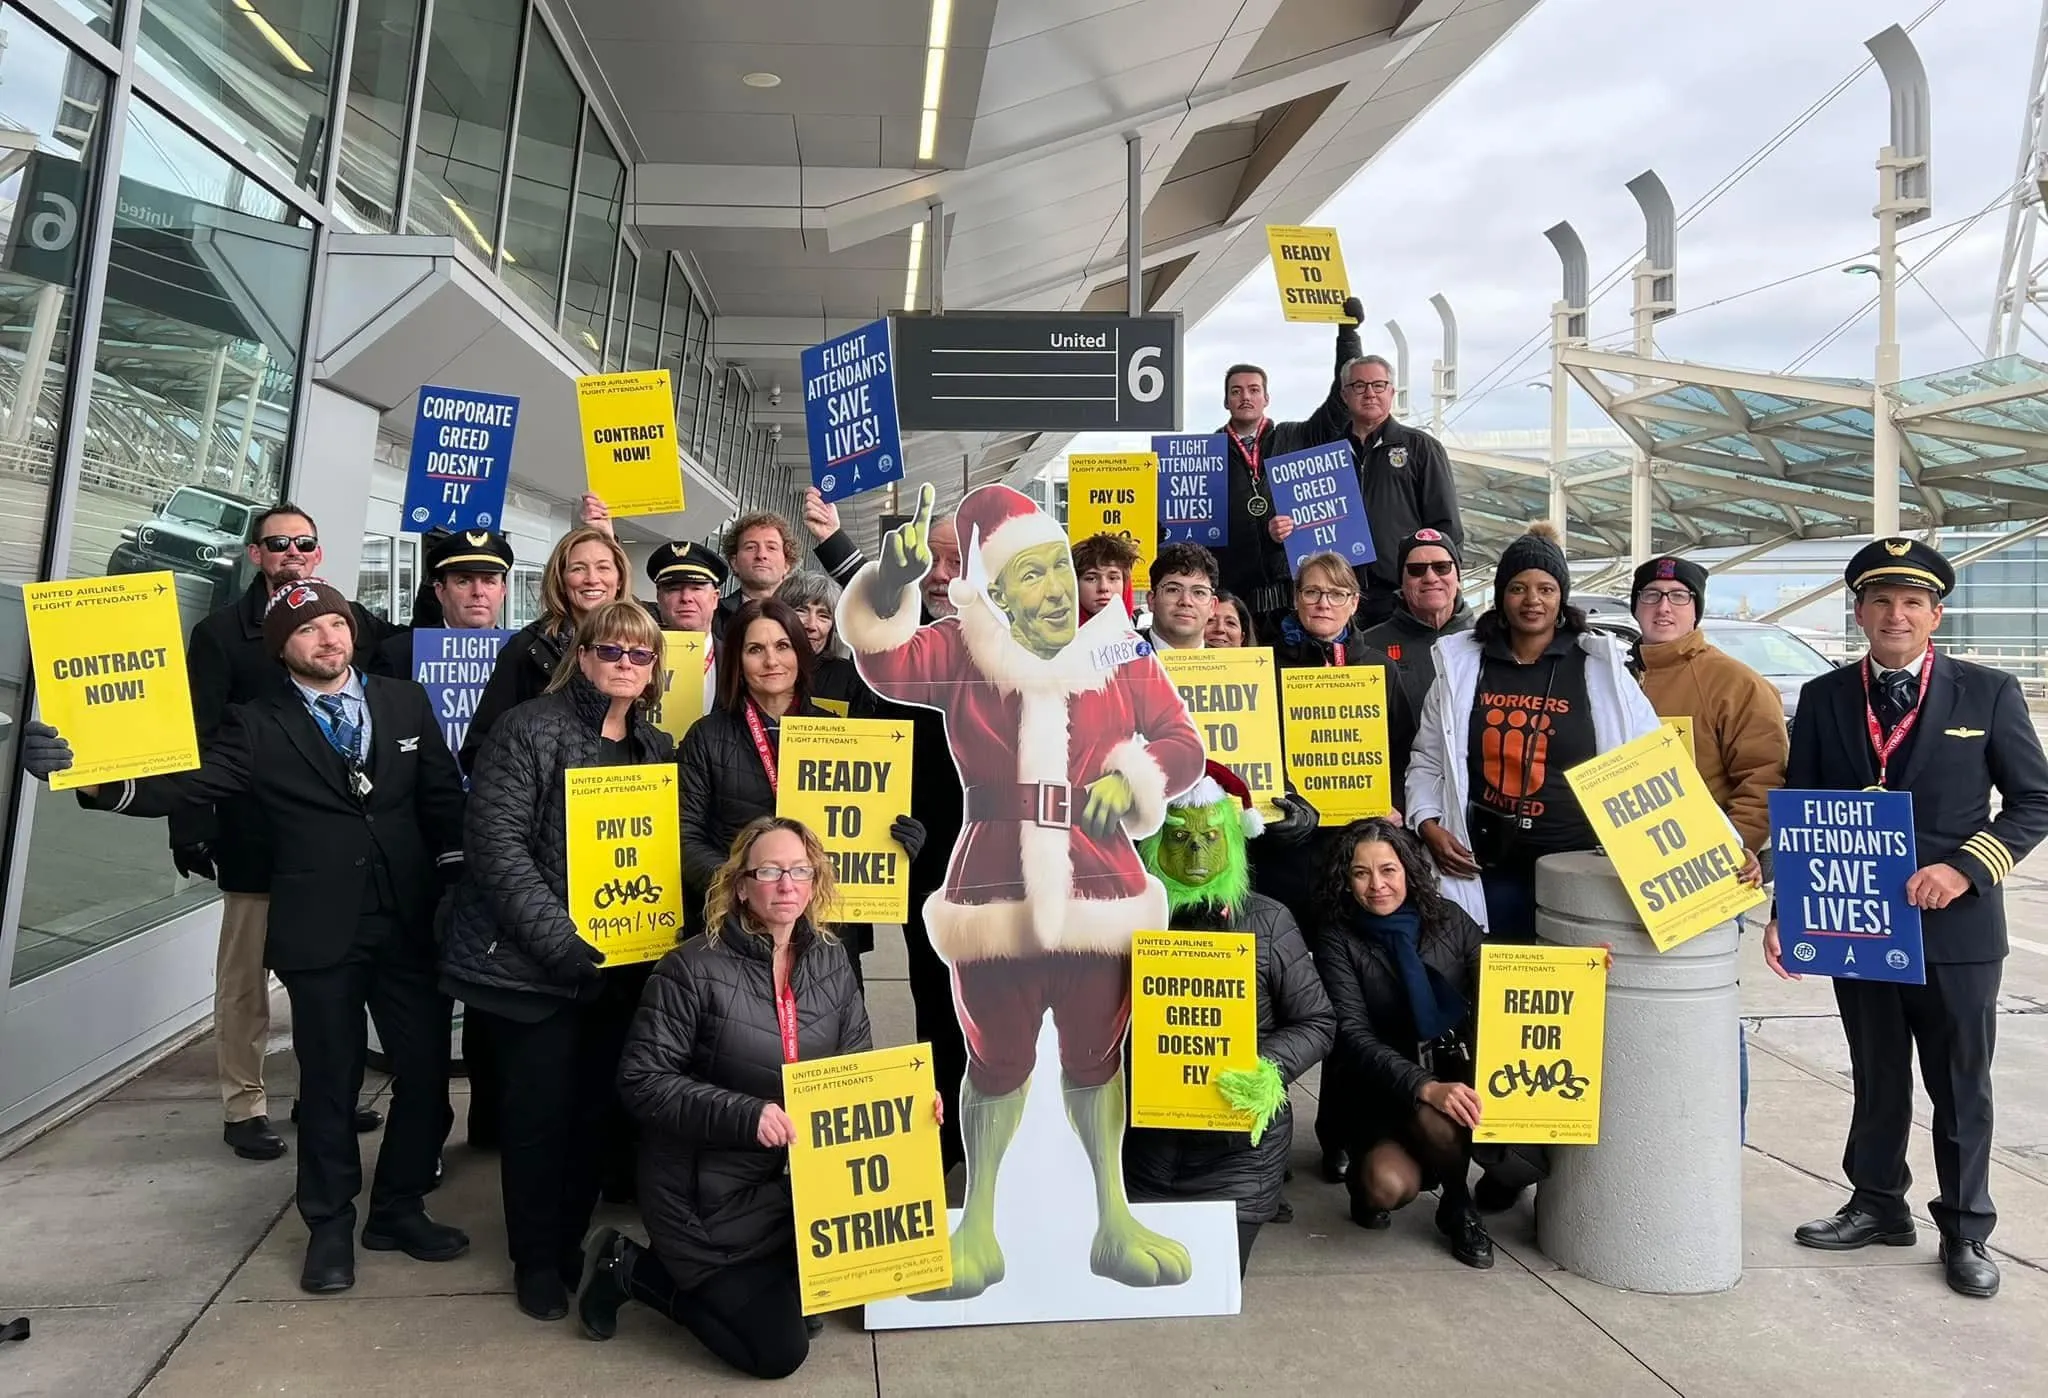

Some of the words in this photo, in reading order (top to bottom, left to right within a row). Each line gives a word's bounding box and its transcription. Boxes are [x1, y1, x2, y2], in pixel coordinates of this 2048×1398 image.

[1281, 245, 1330, 261] READY
[1300, 266, 1322, 282] TO
[1286, 287, 1346, 304] STRIKE!
[1050, 332, 1106, 348] United
[823, 334, 866, 371] FLIGHT
[608, 378, 639, 386] AIRLINES
[808, 351, 887, 401] ATTENDANTS
[1127, 346, 1165, 403] 6
[607, 385, 653, 394] ATTENDANTS
[423, 396, 513, 427] CORPORATE
[827, 384, 872, 427] SAVE
[439, 425, 489, 450] GREED
[594, 424, 664, 443] CONTRACT
[825, 414, 881, 462] LIVES!
[613, 446, 651, 463] NOW!
[1169, 439, 1208, 456] FLIGHT
[427, 451, 494, 478] DOESN'T
[1157, 456, 1224, 473] ATTENDANTS
[1271, 449, 1349, 484] CORPORATE
[442, 482, 471, 504] FLY
[1089, 489, 1113, 504] PAY
[1117, 488, 1135, 503] US
[1170, 475, 1207, 496] SAVE
[1293, 476, 1337, 502] GREED
[1103, 509, 1121, 524] OR
[1166, 498, 1213, 520] LIVES!
[1292, 496, 1348, 526] DOESN'T
[1314, 524, 1337, 546] FLY
[31, 590, 73, 600] UNITED
[76, 584, 125, 596] AIRLINES
[33, 600, 72, 610] FLIGHT
[76, 593, 148, 606] ATTENDANTS
[442, 637, 500, 659] FLIGHT
[1098, 640, 1136, 666] KIRBY
[53, 648, 167, 680] CONTRACT
[417, 661, 496, 683] ATTENDA
[85, 679, 145, 706] NOW!
[1315, 681, 1366, 689] ATTENDANTS
[441, 688, 484, 718] SAV
[1178, 683, 1258, 713] READY
[1480, 692, 1569, 713] WORKERS
[1290, 706, 1336, 720] WORLD
[1339, 704, 1380, 719] CLASS
[786, 724, 814, 732] UNITED
[1204, 723, 1238, 752] TO
[1310, 728, 1362, 744] AIRLINE,
[786, 736, 811, 744] FLIGHT
[812, 737, 858, 745] ATTENDANTS
[1292, 752, 1338, 767] WORLD
[1342, 751, 1382, 766] CLASS
[1575, 767, 1597, 781] UNITED
[1597, 755, 1623, 770] AIRLINES
[571, 777, 603, 785] UNITED
[605, 774, 641, 782] AIRLINES
[798, 759, 891, 792] READY
[1304, 775, 1373, 791] CONTRACT
[1581, 779, 1600, 792] FLIGHT
[1600, 761, 1639, 783] ATTENDANTS
[571, 787, 601, 796] FLIGHT
[603, 784, 658, 794] ATTENDANTS
[1602, 766, 1685, 829] READY
[824, 805, 862, 838] TO
[1804, 799, 1875, 826] FLIGHT
[596, 818, 626, 840] PAY
[630, 816, 653, 837] US
[1645, 818, 1687, 857] TO
[1778, 827, 1907, 857] ATTENDANTS
[614, 847, 637, 868] OR
[825, 852, 897, 885] RIKE!
[1639, 843, 1738, 913] STRIKE!
[1809, 858, 1880, 895] SAVE
[593, 874, 663, 909] CHAOS
[1803, 896, 1892, 935] LIVES!
[1138, 938, 1170, 946] UNITED
[1173, 939, 1214, 947] AIRLINES
[1138, 949, 1168, 957] FLIGHT
[1171, 950, 1232, 959] ATTENDANTS
[1513, 965, 1556, 973] ATTENDANTS
[1142, 975, 1245, 999] CORPORATE
[1504, 989, 1575, 1015] READY
[1166, 1005, 1222, 1027] GREED
[1158, 1034, 1230, 1057] DOESN'T
[1521, 1024, 1561, 1050] FOR
[792, 1069, 822, 1080] UNITED
[823, 1063, 858, 1075] AIRLINES
[1183, 1064, 1210, 1085] FLY
[1488, 1058, 1590, 1101] CHAOS
[793, 1083, 821, 1095] FLIGHT
[822, 1075, 874, 1090] ATTENDANTS
[810, 1095, 914, 1149] READY
[846, 1153, 890, 1197] TO
[810, 1199, 935, 1260] STRIKE!
